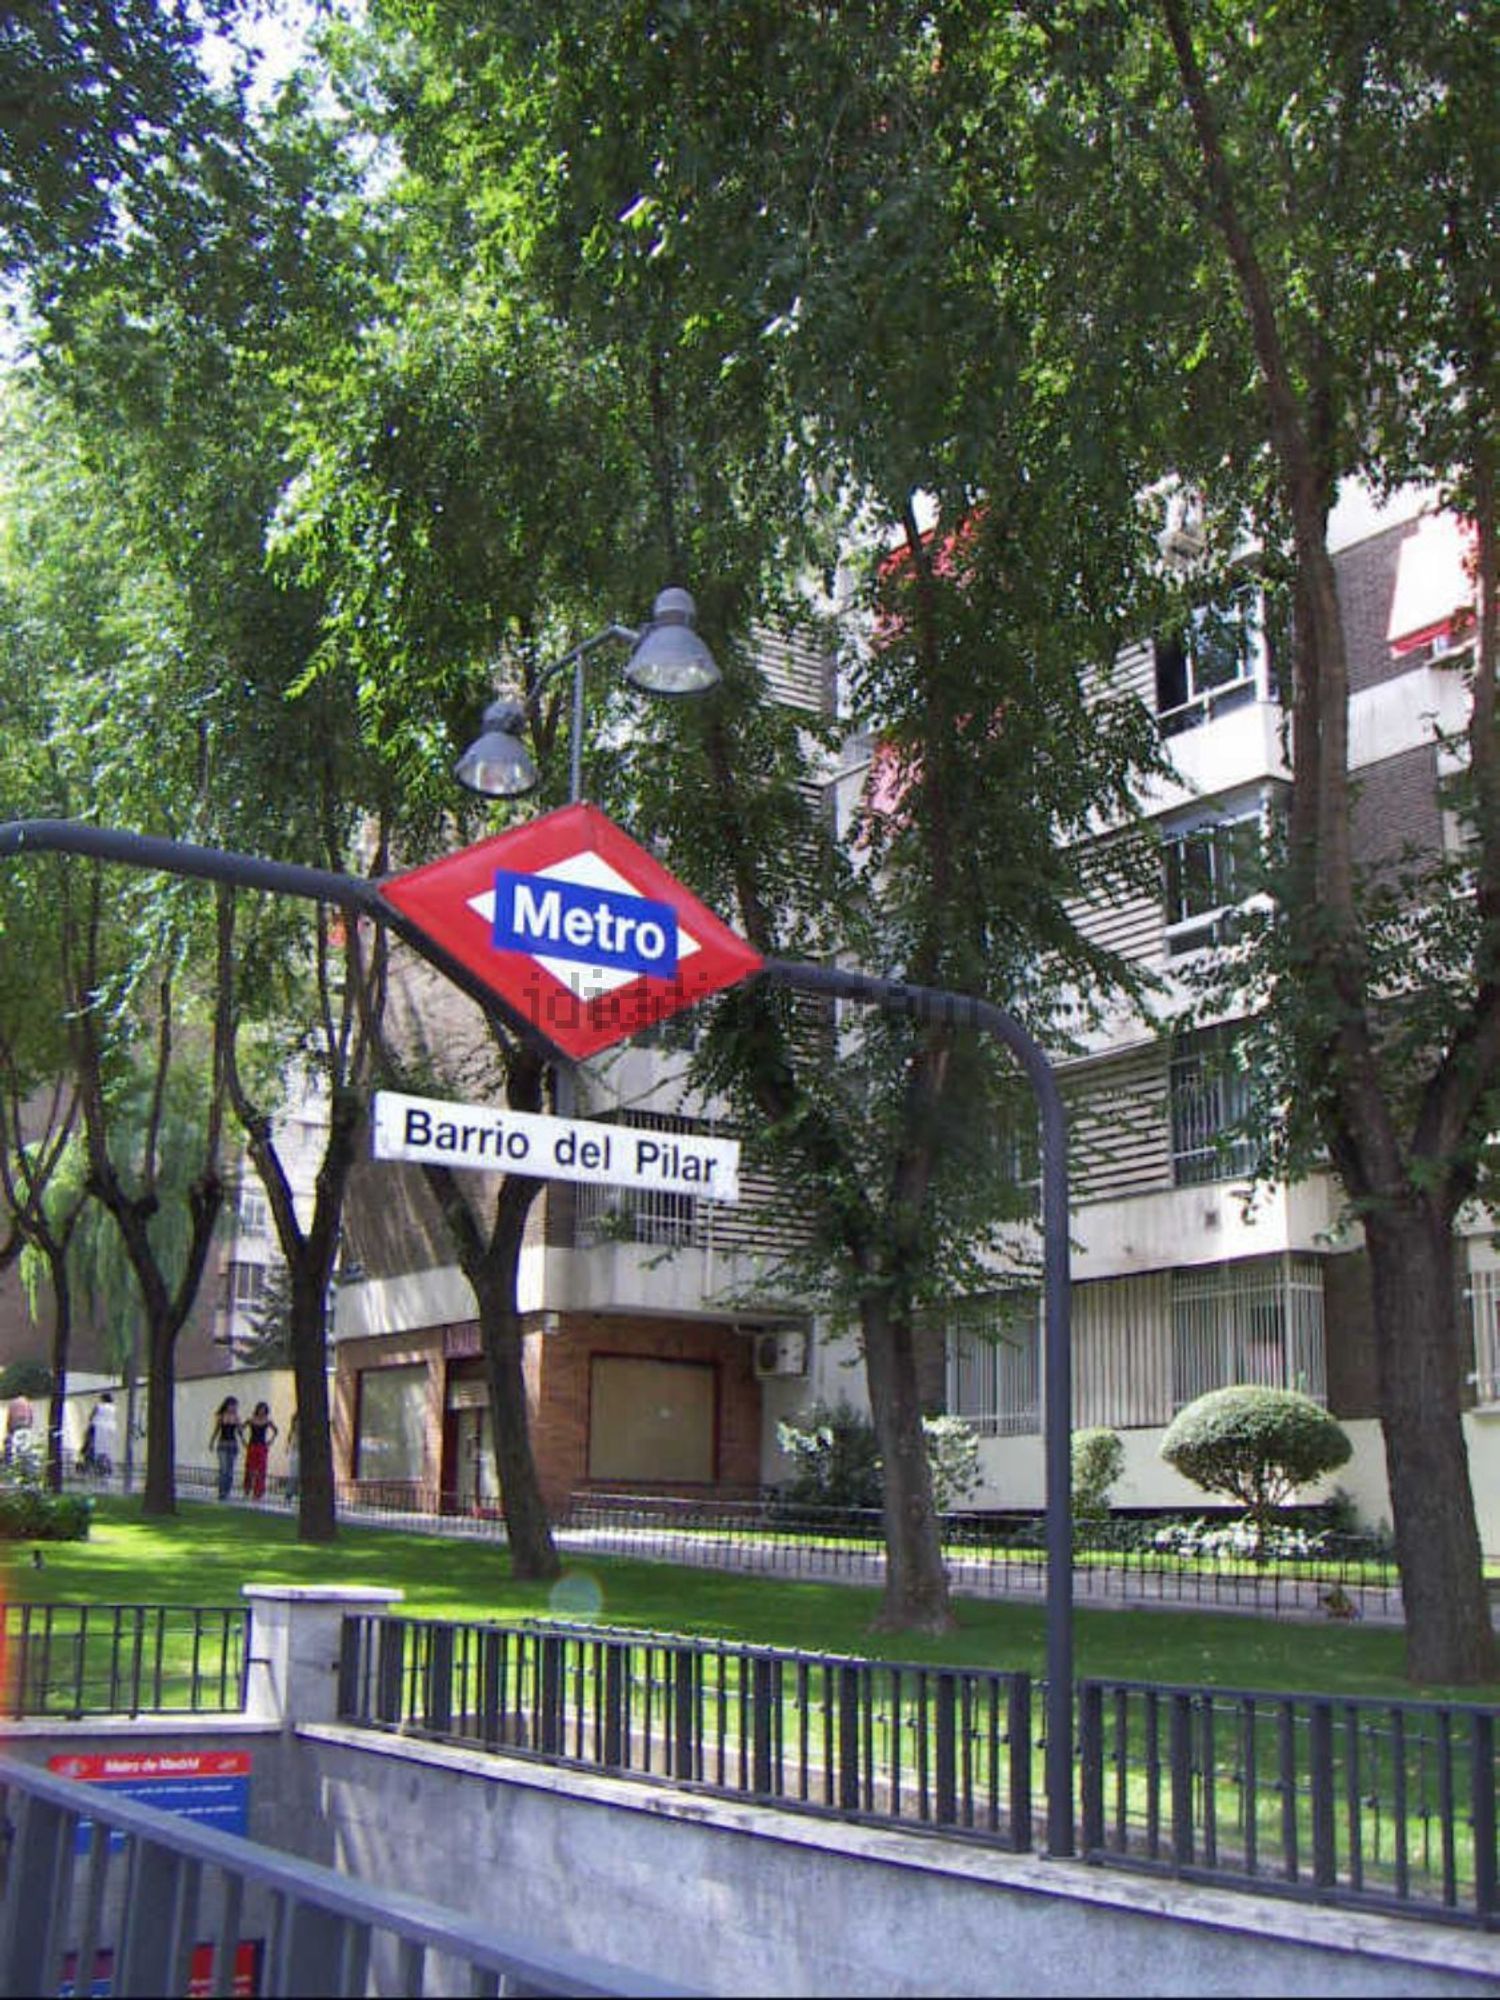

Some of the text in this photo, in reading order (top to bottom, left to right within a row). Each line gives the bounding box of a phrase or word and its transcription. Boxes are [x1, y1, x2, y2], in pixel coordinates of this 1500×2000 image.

[513, 883, 667, 960] Metro
[403, 1109, 718, 1183] Barrio del Pilar
